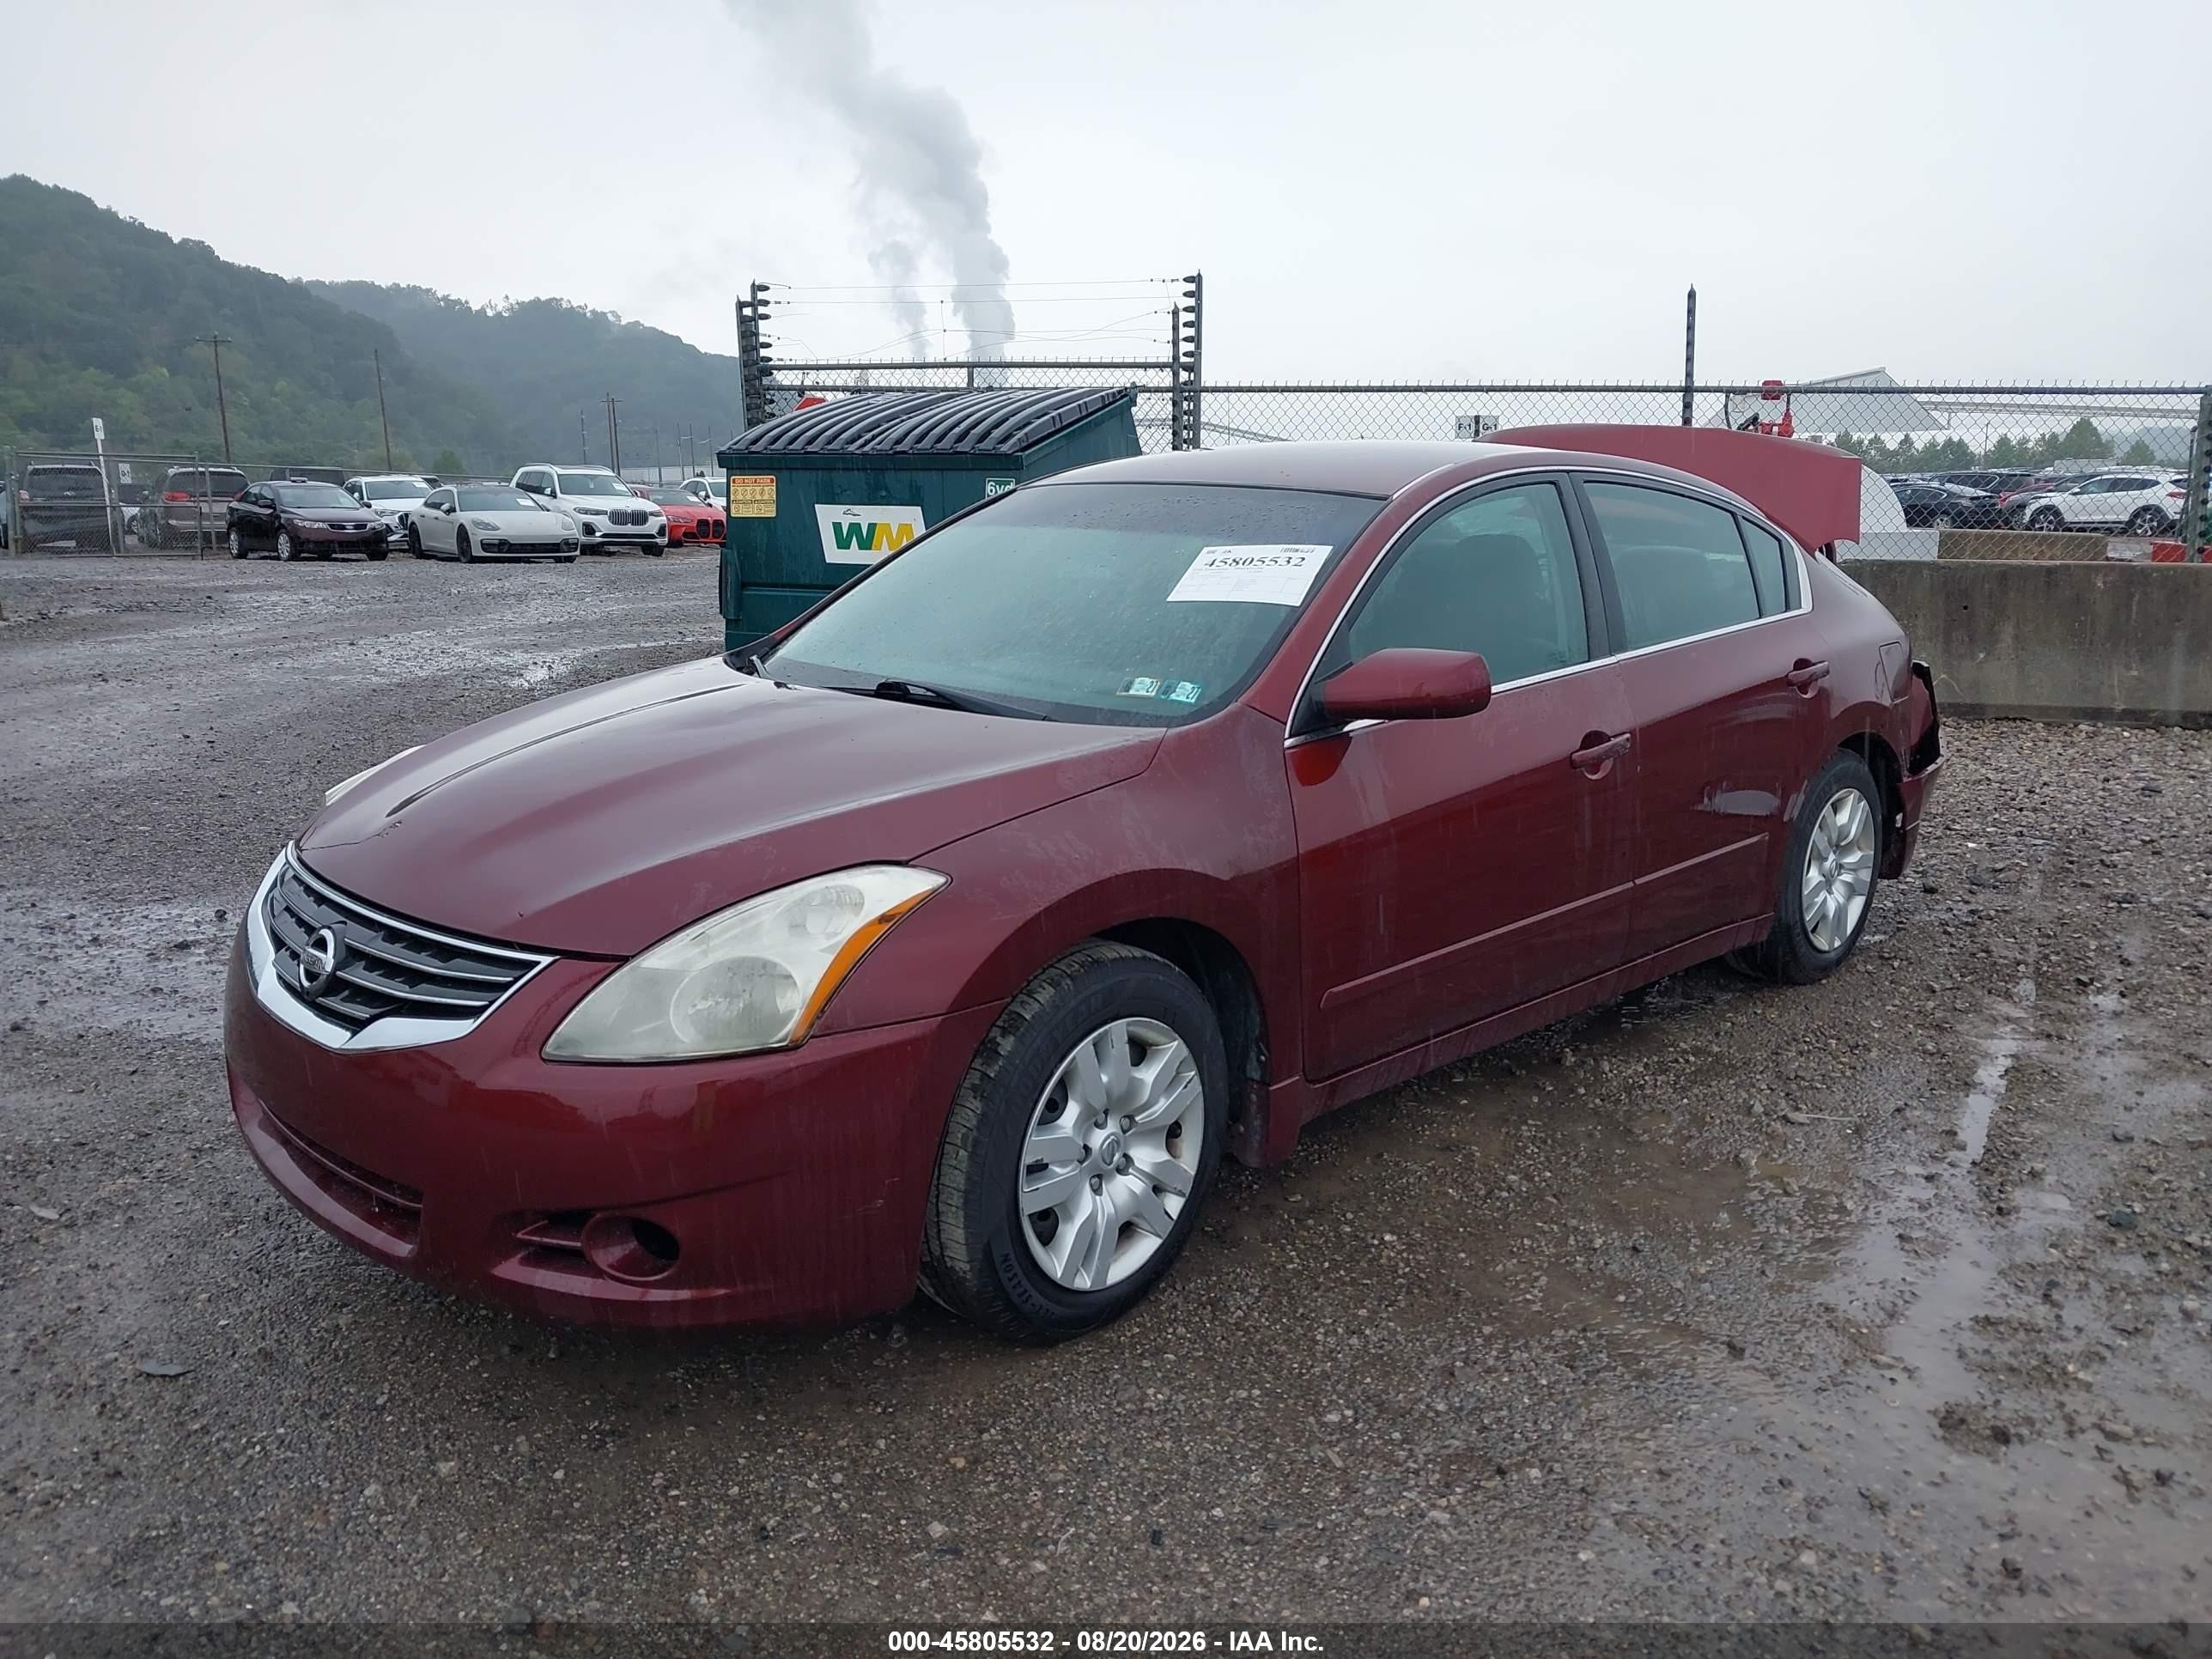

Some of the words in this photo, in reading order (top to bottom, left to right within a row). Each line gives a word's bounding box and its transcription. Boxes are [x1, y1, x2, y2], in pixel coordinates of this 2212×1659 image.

[1482, 422, 1498, 431] G-1
[832, 521, 915, 550] WM
[1204, 556, 1306, 568] 45805532
